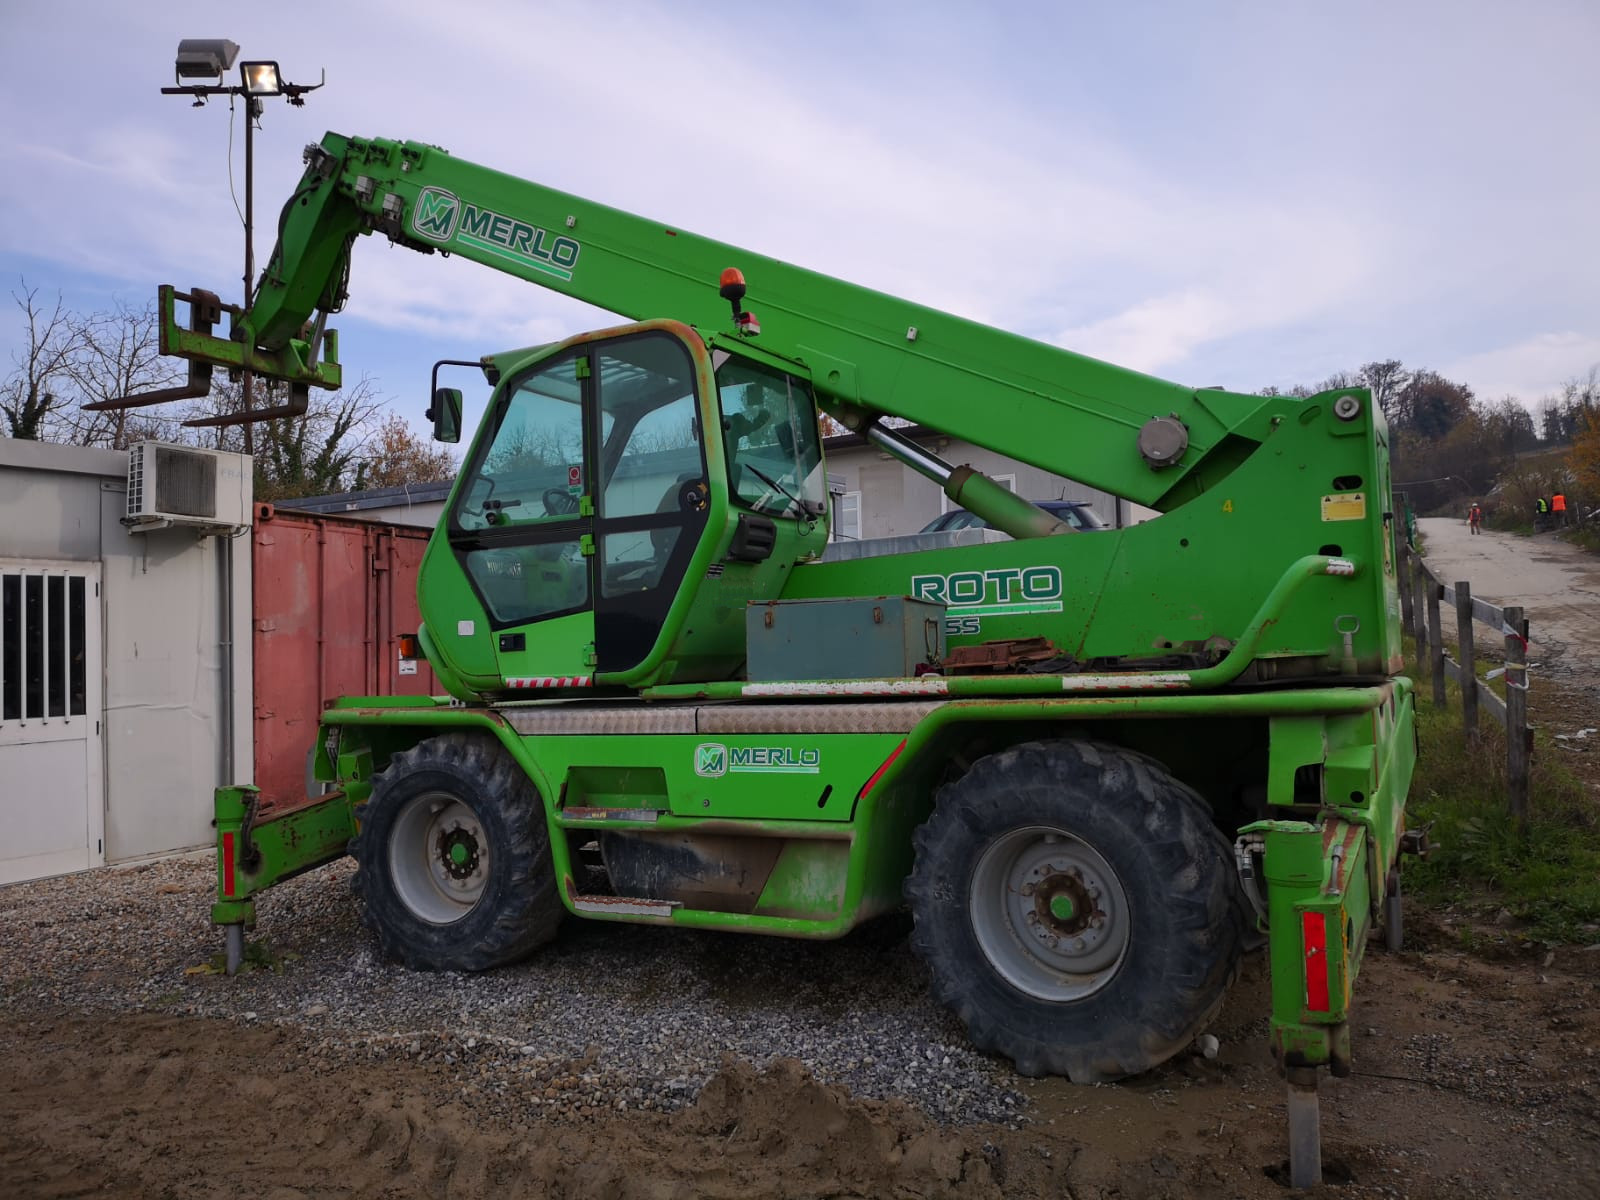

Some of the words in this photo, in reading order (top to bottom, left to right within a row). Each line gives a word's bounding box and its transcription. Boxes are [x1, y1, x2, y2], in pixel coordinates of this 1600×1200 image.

[461, 205, 580, 269] MERLO
[1222, 499, 1234, 513] 4
[912, 565, 1063, 605] ROTO
[730, 748, 820, 767] MERLO
